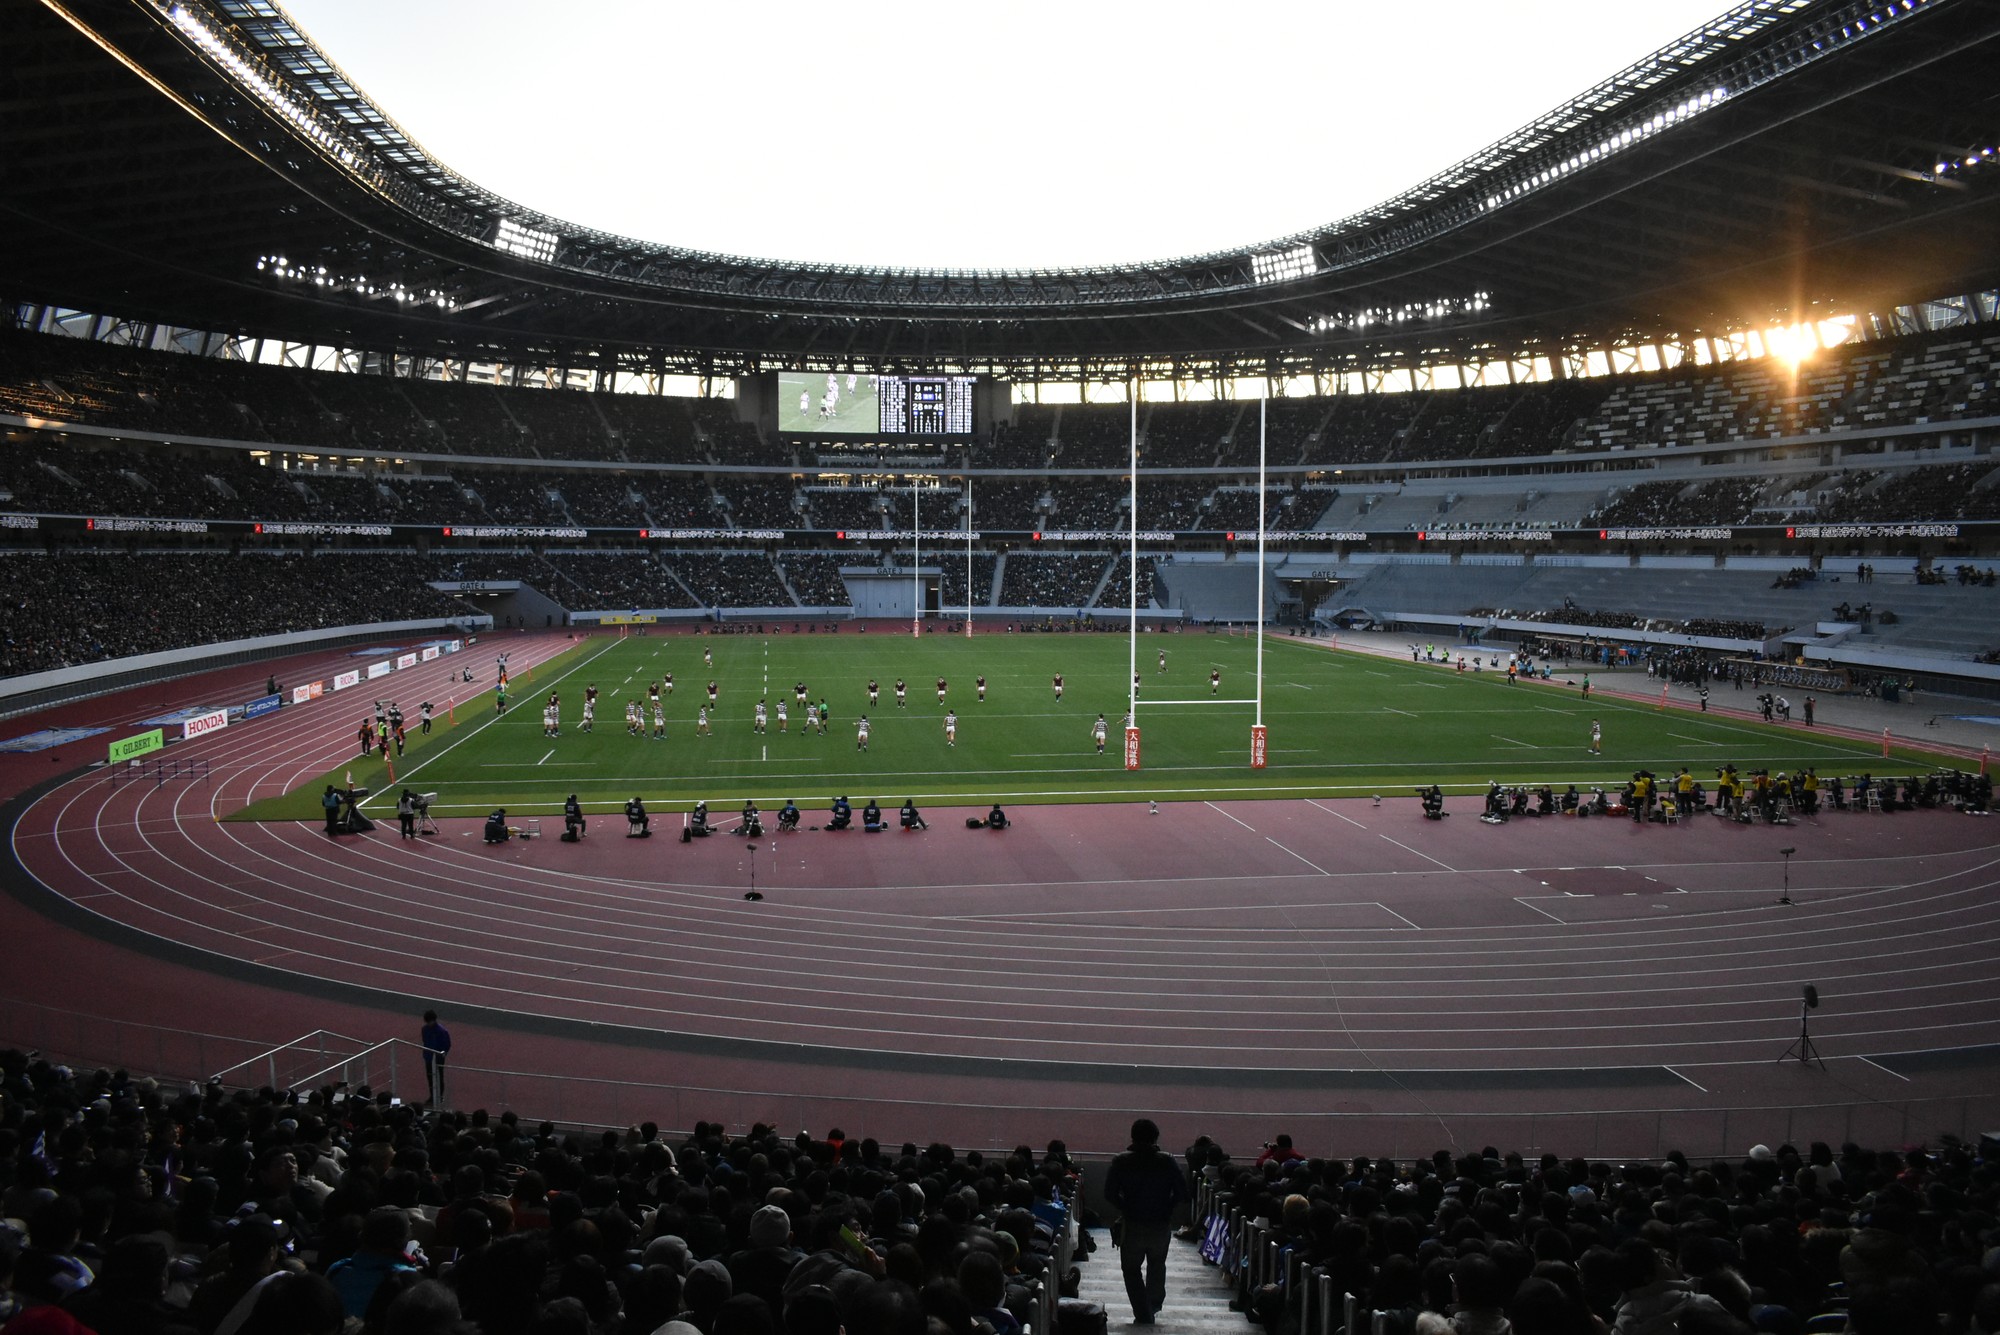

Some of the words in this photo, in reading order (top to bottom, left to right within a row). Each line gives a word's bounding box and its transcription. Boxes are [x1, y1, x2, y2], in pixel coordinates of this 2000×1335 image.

[915, 384, 921, 392] 0
[934, 384, 942, 392] 31
[912, 403, 923, 411] 28
[933, 403, 944, 411] 45
[1795, 528, 1820, 538] 第56回
[1821, 524, 1958, 538] 全国大学ラグビーフットボール選手権大会
[877, 567, 898, 575] GATE
[898, 567, 903, 575] 3
[460, 582, 480, 590] GATE
[480, 582, 485, 590] 4
[188, 713, 225, 735] HONDA
[122, 738, 152, 756] GILBERT
[1129, 731, 1138, 767] 大和証券
[1256, 730, 1265, 766] 大和証券
